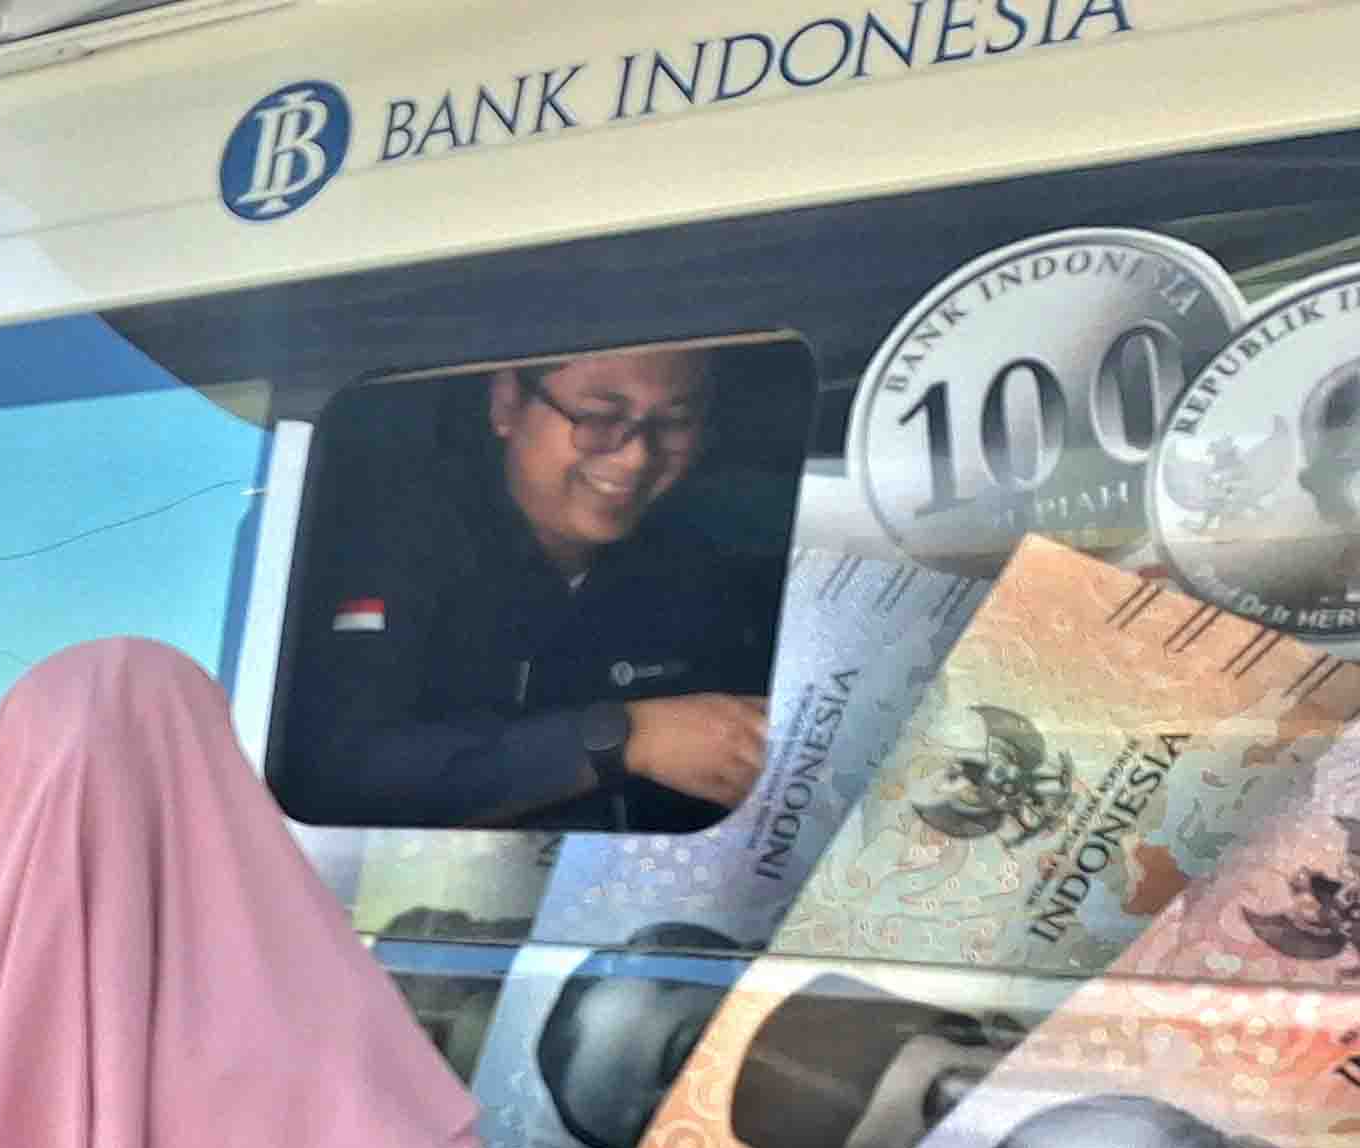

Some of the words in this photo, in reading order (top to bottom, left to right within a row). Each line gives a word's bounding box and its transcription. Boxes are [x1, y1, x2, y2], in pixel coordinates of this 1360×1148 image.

[376, 63, 583, 162] BANK
[609, 0, 1134, 120] INDONESIA
[884, 302, 968, 393] BANK
[898, 318, 1185, 515] 100
[1173, 301, 1325, 435] REPUBLIK
[755, 668, 862, 880] INDONESIA
[1028, 734, 1192, 943] INDONESIA
